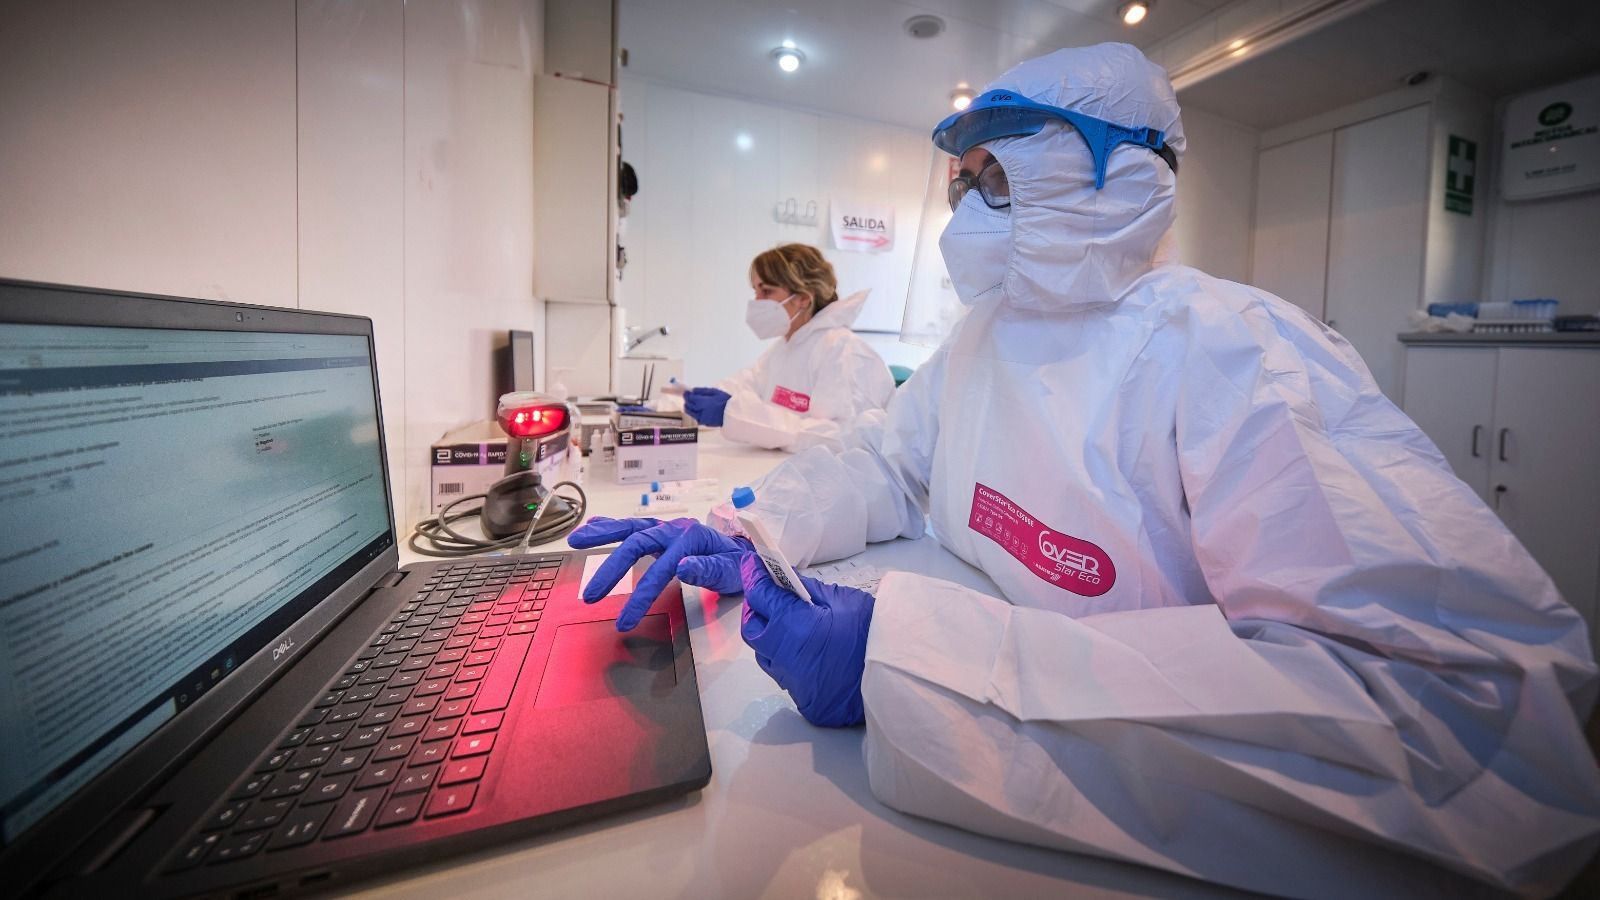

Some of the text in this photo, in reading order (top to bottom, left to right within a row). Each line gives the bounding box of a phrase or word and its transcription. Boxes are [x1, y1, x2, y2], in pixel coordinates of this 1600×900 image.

[842, 215, 886, 230] SALIDA
[1054, 562, 1100, 585] Star Eco
[272, 636, 295, 661] DELL
